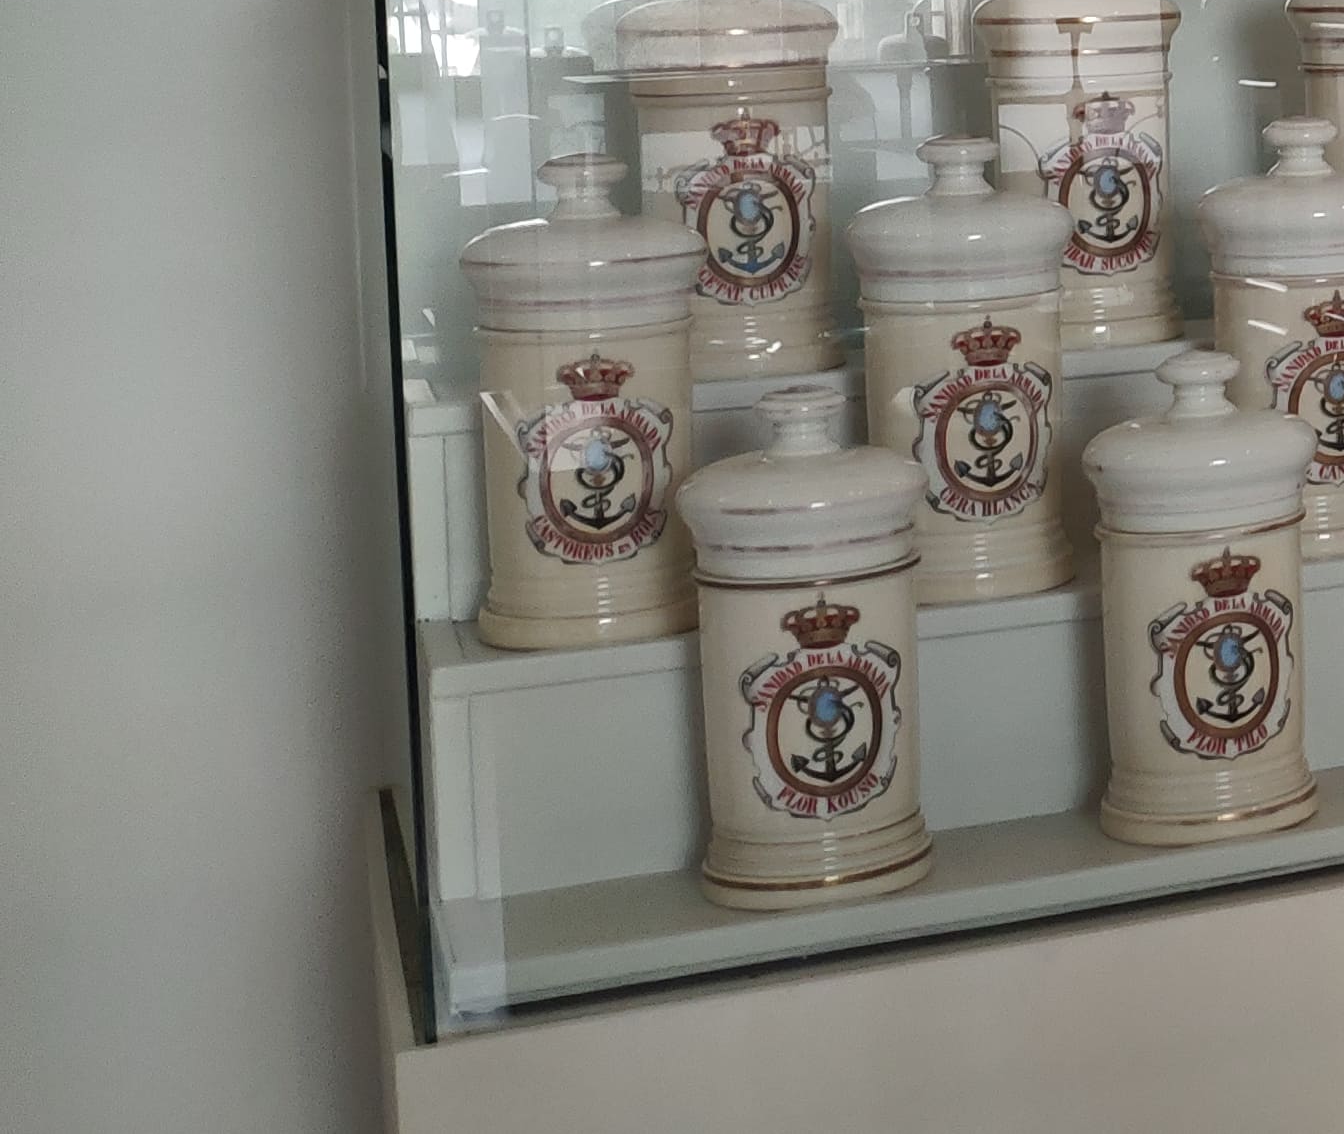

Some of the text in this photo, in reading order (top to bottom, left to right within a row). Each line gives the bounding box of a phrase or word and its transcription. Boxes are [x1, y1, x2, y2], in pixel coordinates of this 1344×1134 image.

[1095, 135, 1109, 146] DE
[1111, 135, 1124, 146] LA
[733, 160, 747, 171] DE
[750, 158, 764, 171] LA
[769, 164, 806, 205] ARMADA
[1272, 344, 1322, 392] SANIDAD
[1325, 340, 1339, 352] DE
[921, 368, 1044, 423] SANIDAD DE LA ARMADA
[582, 403, 597, 415] DE
[599, 402, 616, 416] LA
[620, 409, 661, 452] ARMADA
[940, 486, 977, 516] CERA
[1160, 597, 1286, 660] SANIDAD DE LA ARMADA
[753, 651, 891, 713] SANIDAD DE LA ARMADA
[1186, 725, 1228, 755] FLOR
[777, 772, 879, 814] FLOR KOUSO
